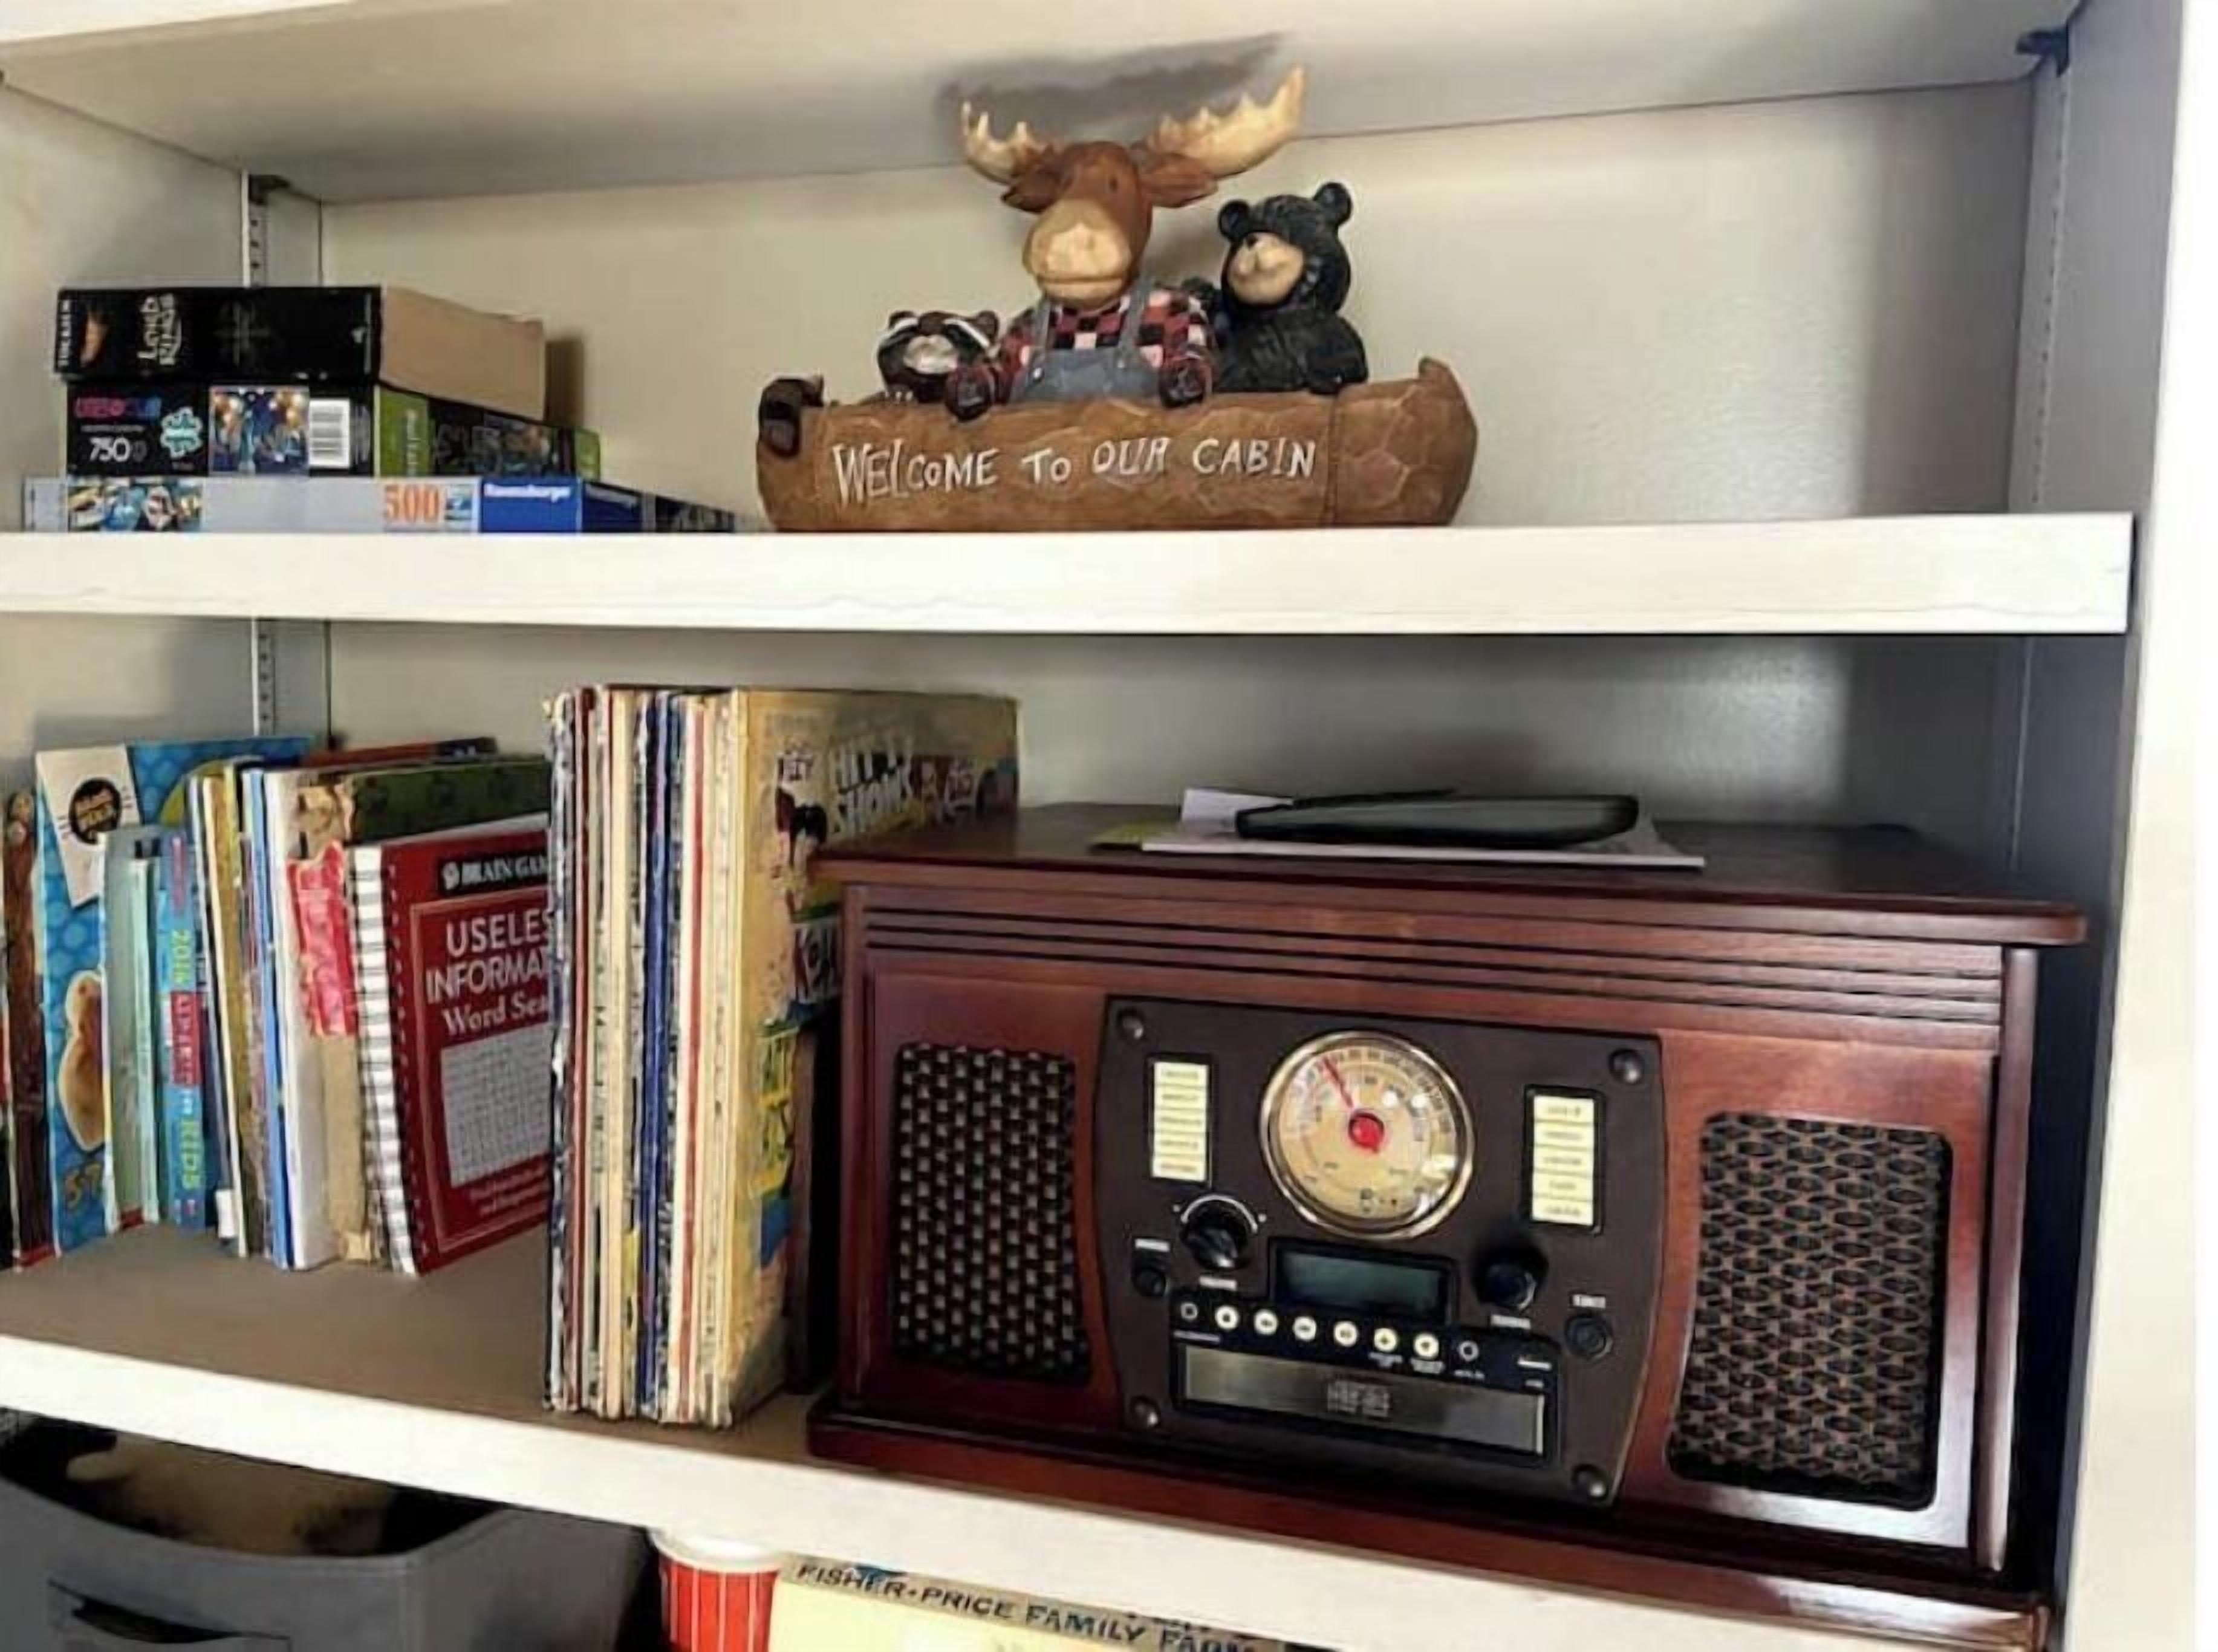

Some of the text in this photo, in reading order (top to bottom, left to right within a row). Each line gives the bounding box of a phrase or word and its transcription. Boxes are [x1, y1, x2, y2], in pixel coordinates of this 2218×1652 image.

[90, 438, 131, 462] 750
[1092, 437, 1172, 475] OUR
[1192, 437, 1316, 478] CABIN
[385, 483, 440, 522] 500
[440, 995, 506, 1036] Word
[1026, 1605, 1145, 1642] FAMILY
